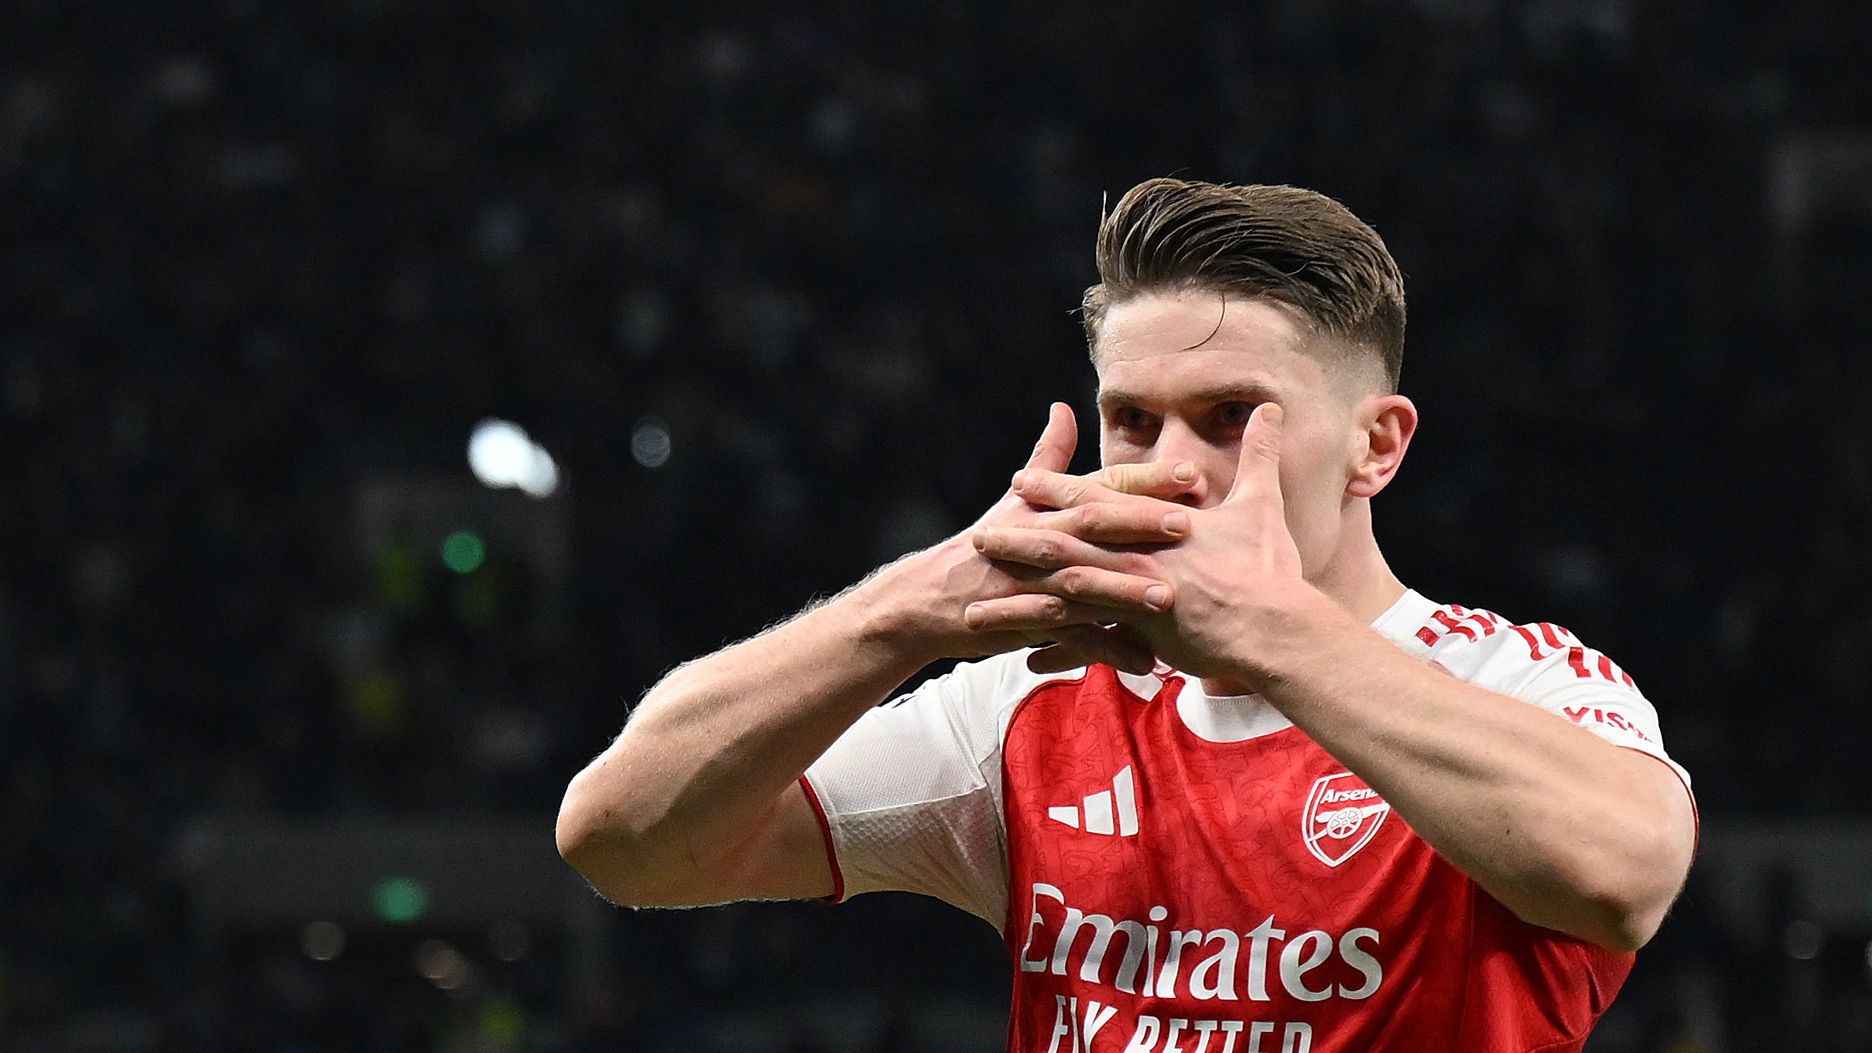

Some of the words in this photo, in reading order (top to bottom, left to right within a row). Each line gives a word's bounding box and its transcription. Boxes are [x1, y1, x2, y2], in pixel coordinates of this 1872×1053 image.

[1563, 706, 1653, 743] VIS
[1320, 788, 1378, 804] Arsen
[1020, 883, 1383, 1002] Emirates
